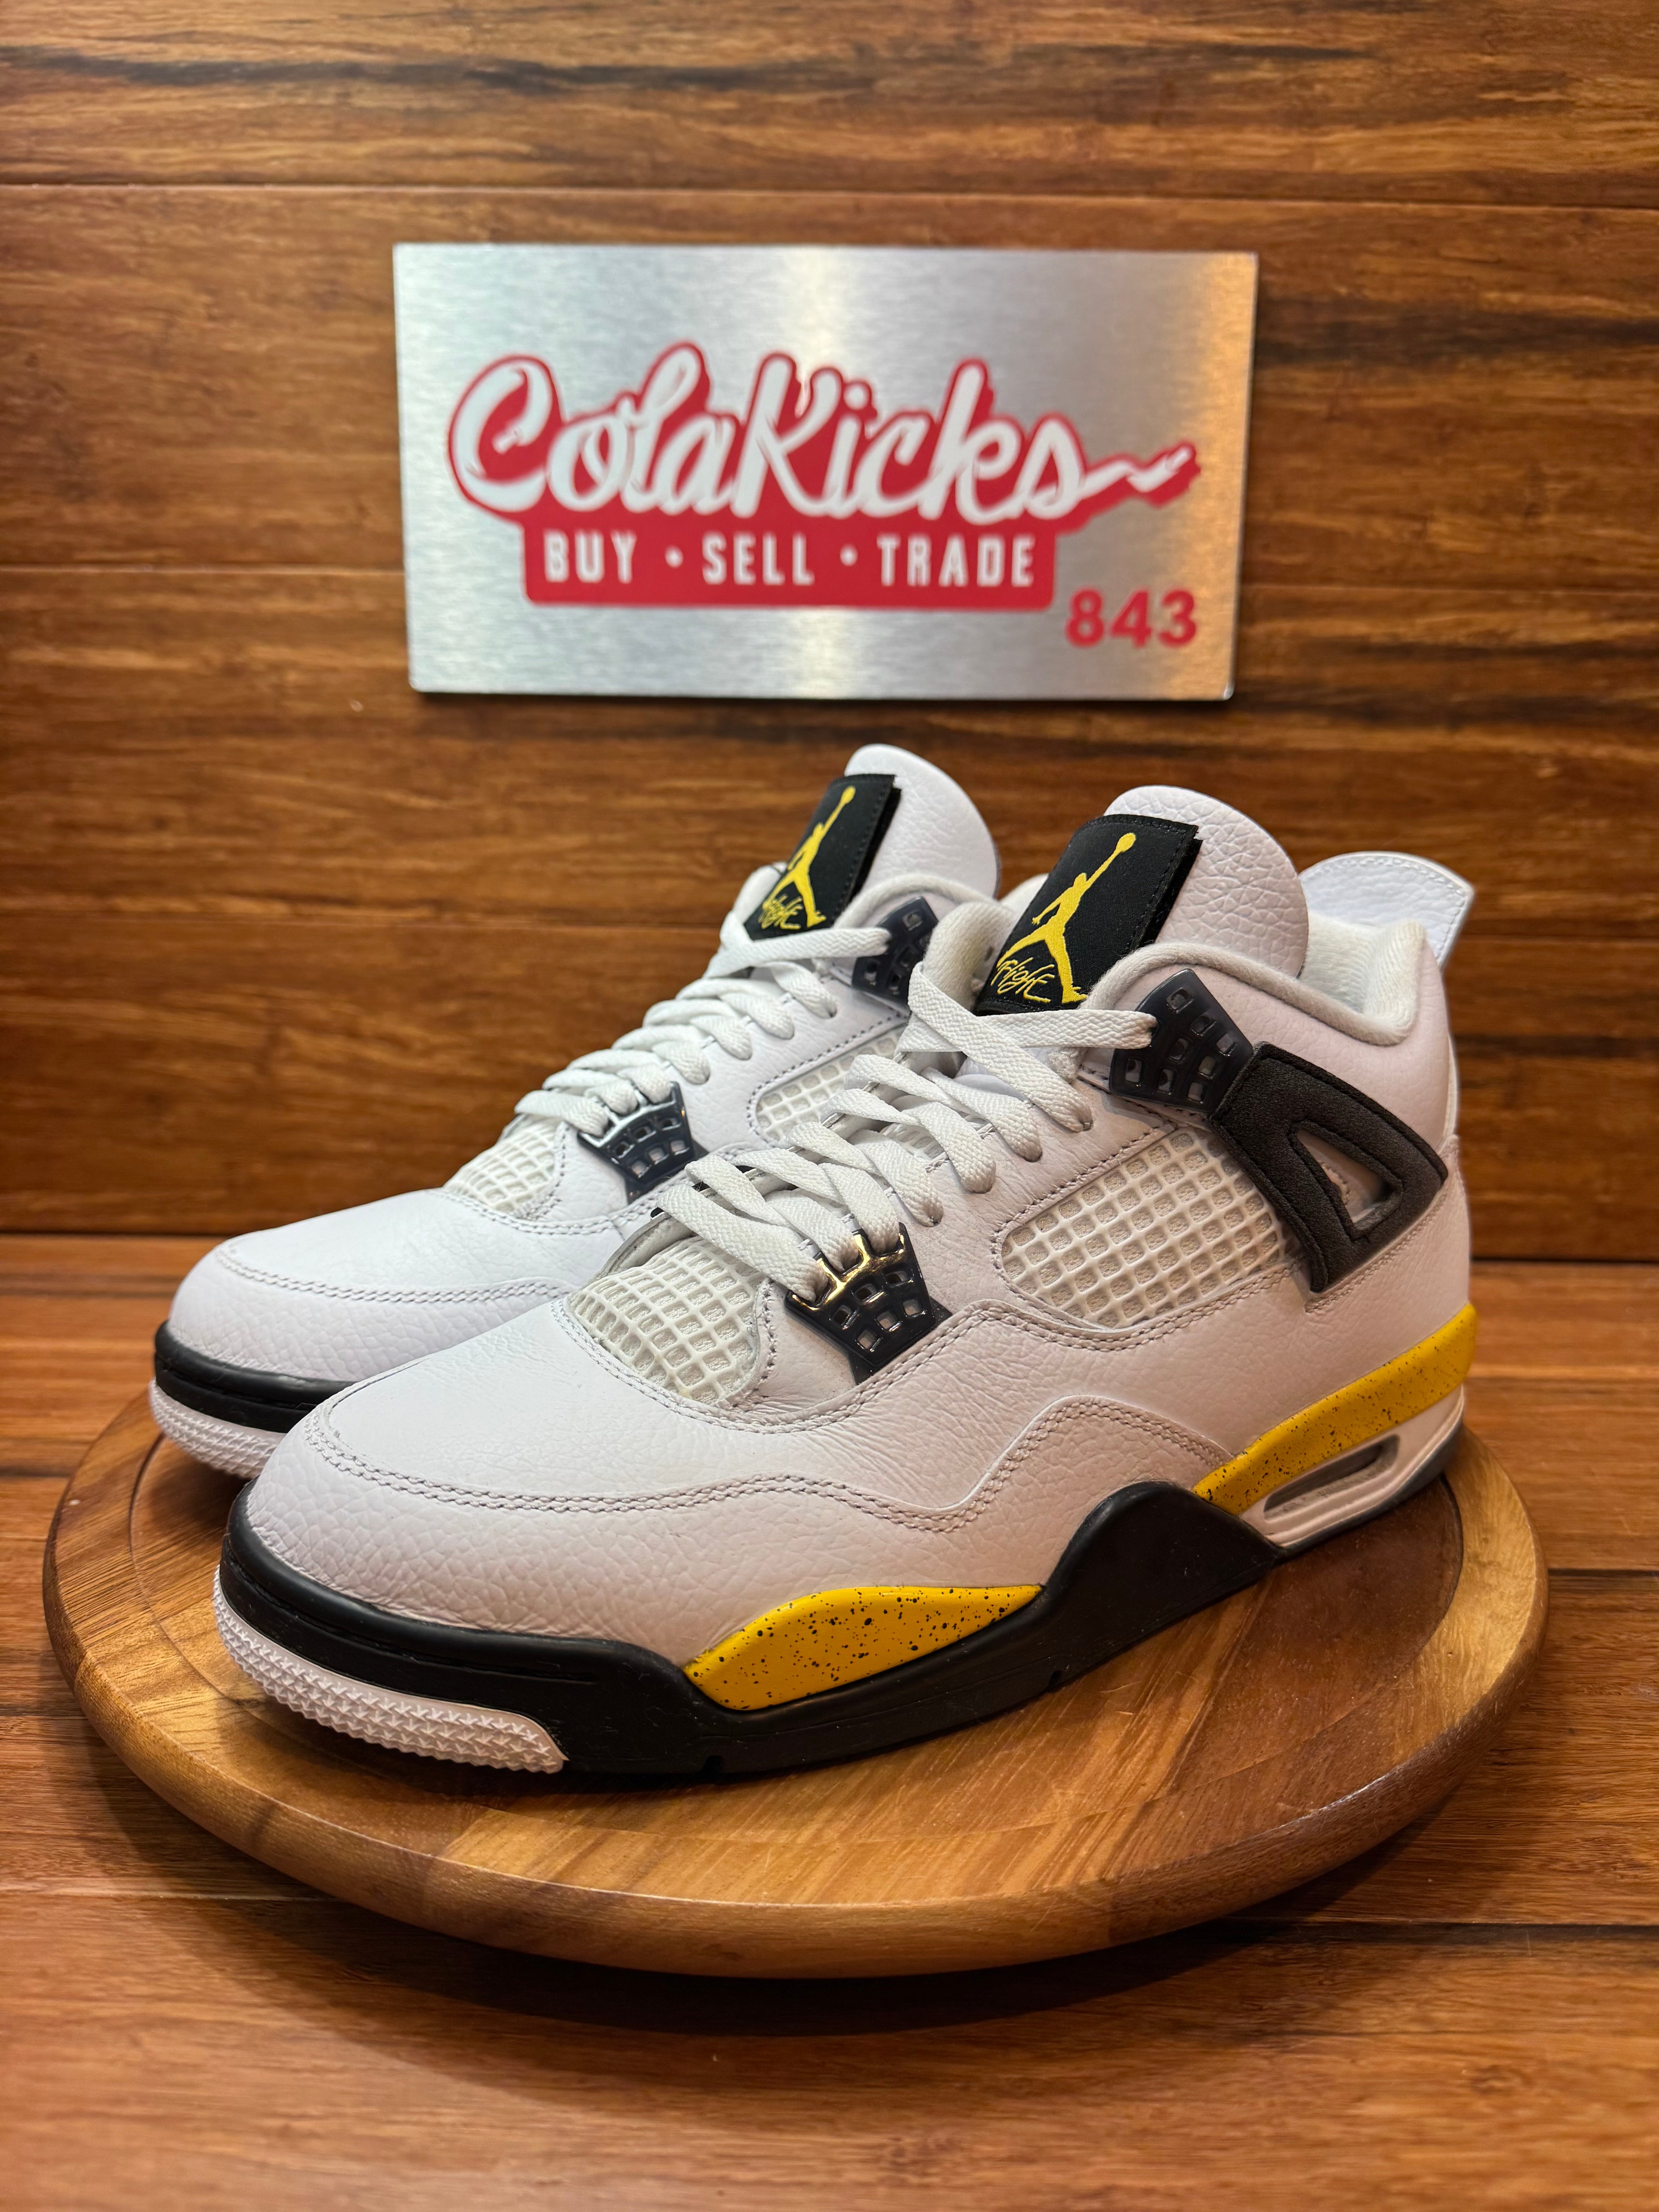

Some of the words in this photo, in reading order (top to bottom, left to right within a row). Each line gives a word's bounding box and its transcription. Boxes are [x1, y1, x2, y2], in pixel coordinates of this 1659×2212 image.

[544, 532, 635, 582] BUY
[702, 534, 814, 585] SELL
[878, 534, 1035, 586] TRADE
[1066, 589, 1198, 647] 843
